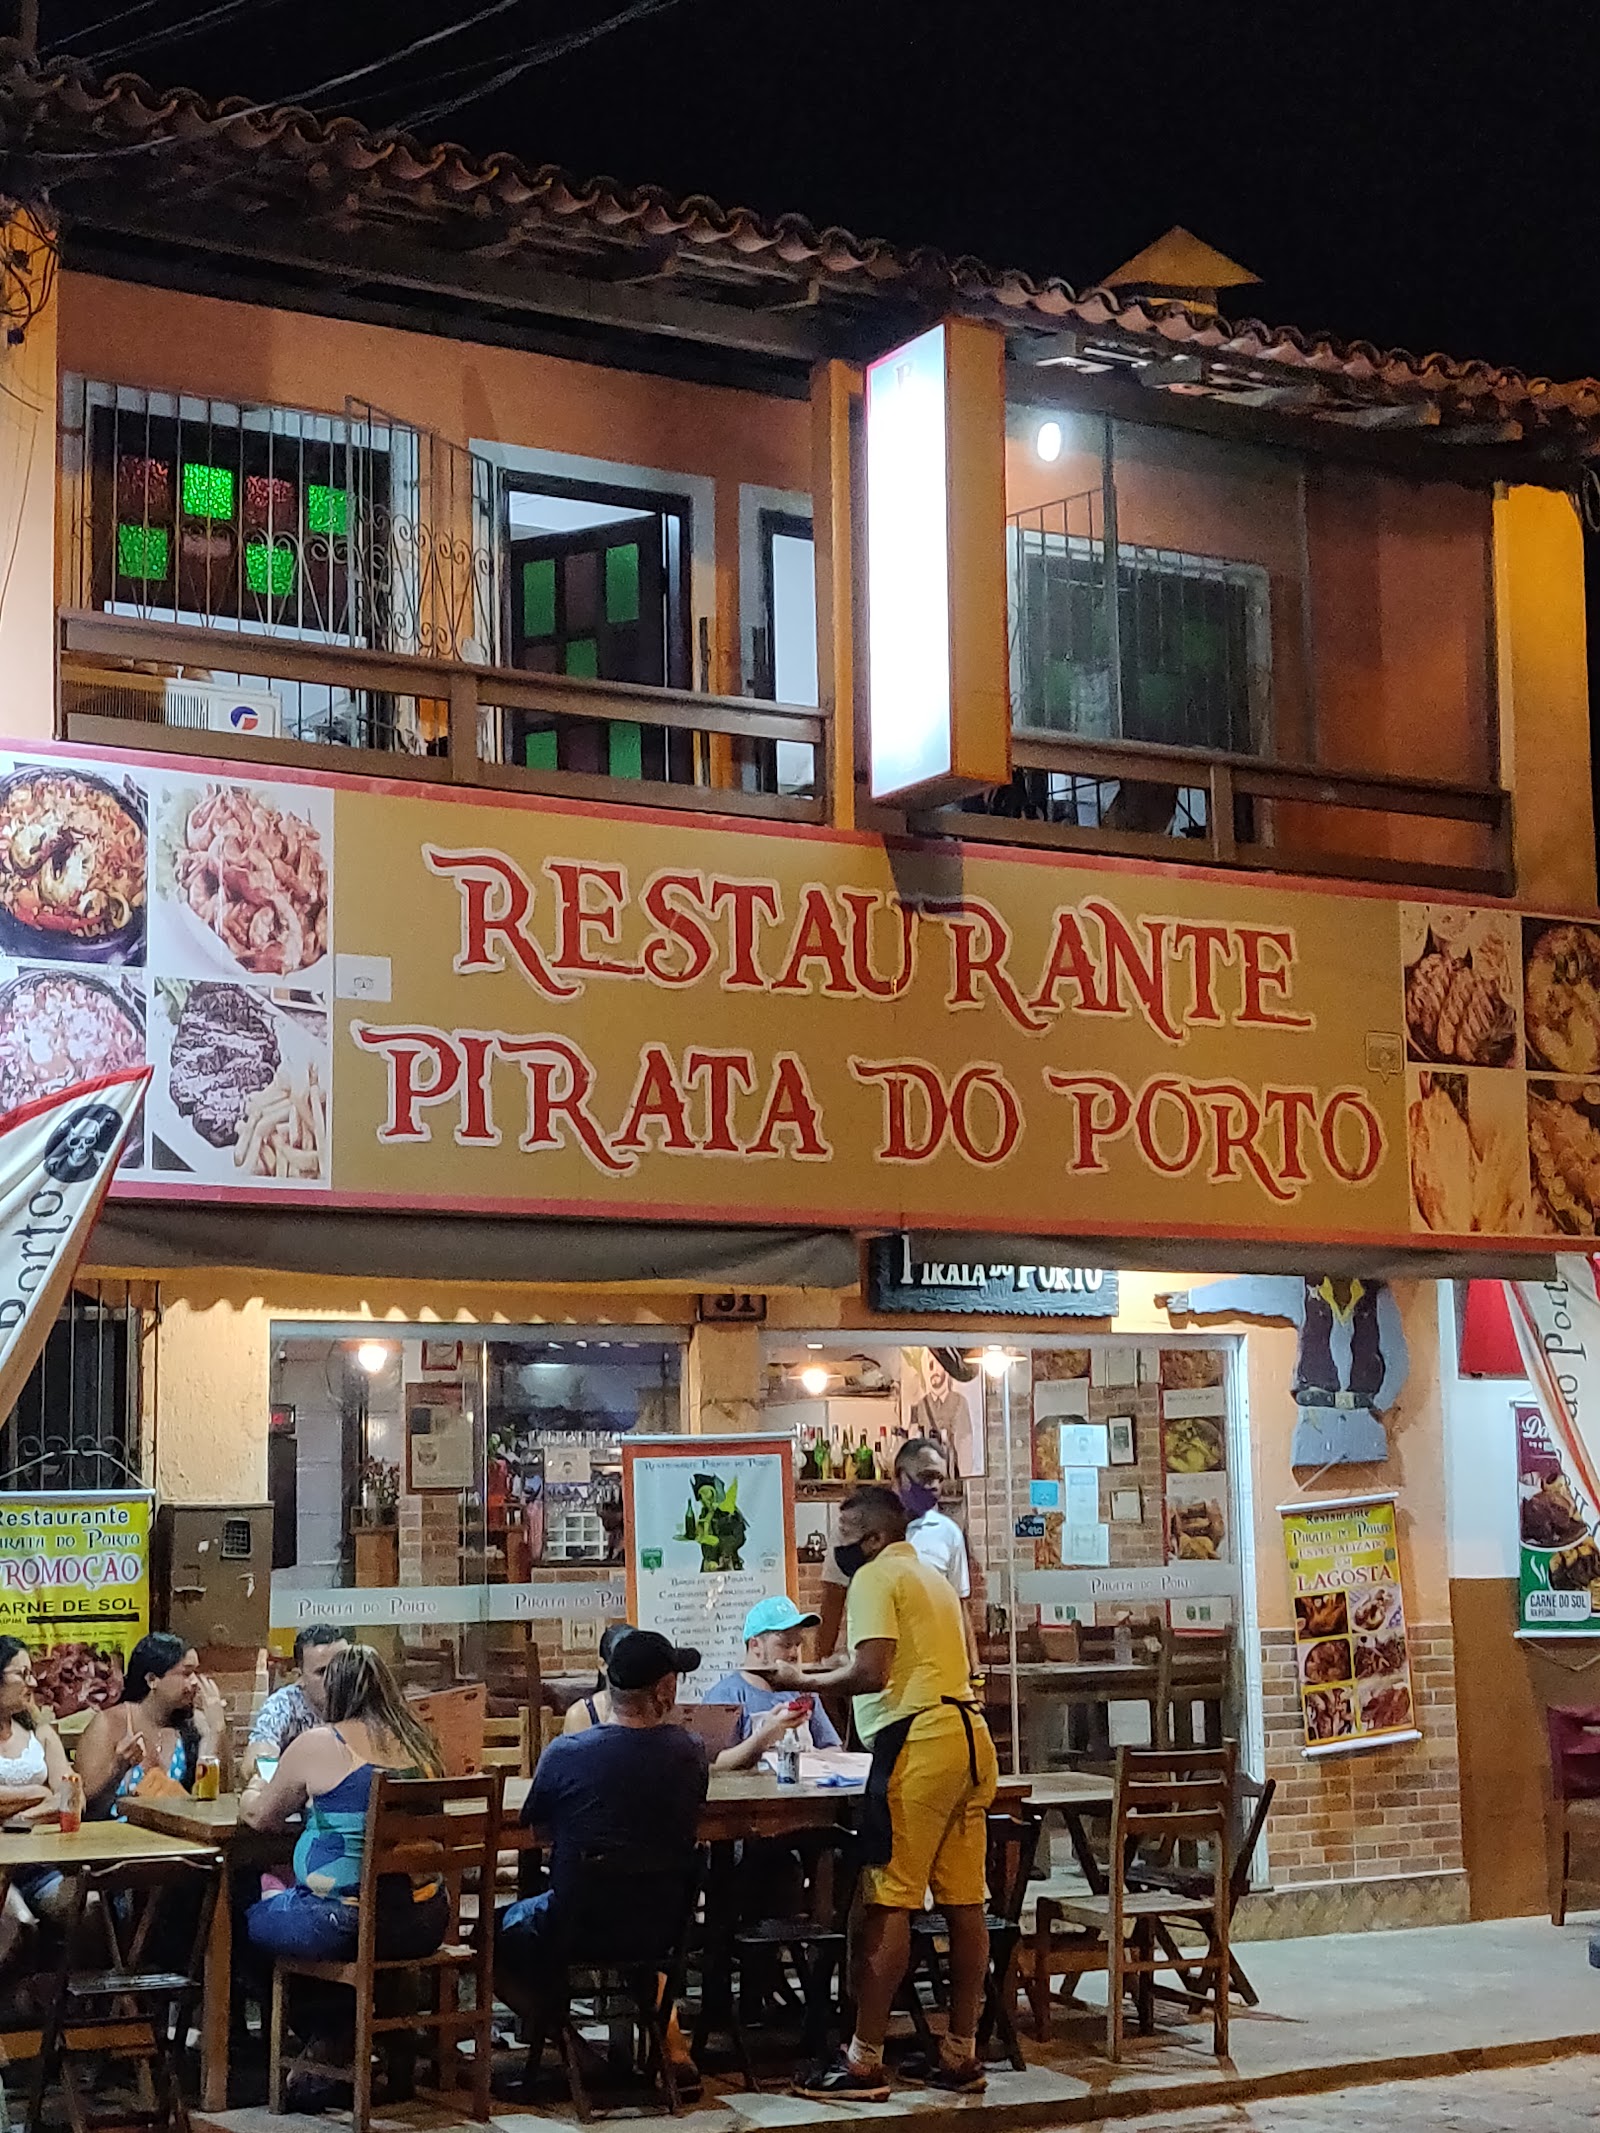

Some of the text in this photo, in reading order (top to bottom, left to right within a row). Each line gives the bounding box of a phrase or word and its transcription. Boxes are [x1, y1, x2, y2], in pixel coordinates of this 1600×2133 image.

[424, 845, 1315, 1043] RESTAURANTE
[353, 1021, 1388, 1203] PIRATA DO PORTO
[1543, 1280, 1587, 1362] Port
[0, 1535, 45, 1550] IRATA
[0, 1552, 140, 1592] ROMOÇÃO
[1297, 1564, 1392, 1591] LAGOSTA
[0, 1597, 140, 1615] ARNE DE SOL
[1530, 1594, 1557, 1608] CARNE
[1571, 1594, 1587, 1609] SOL
